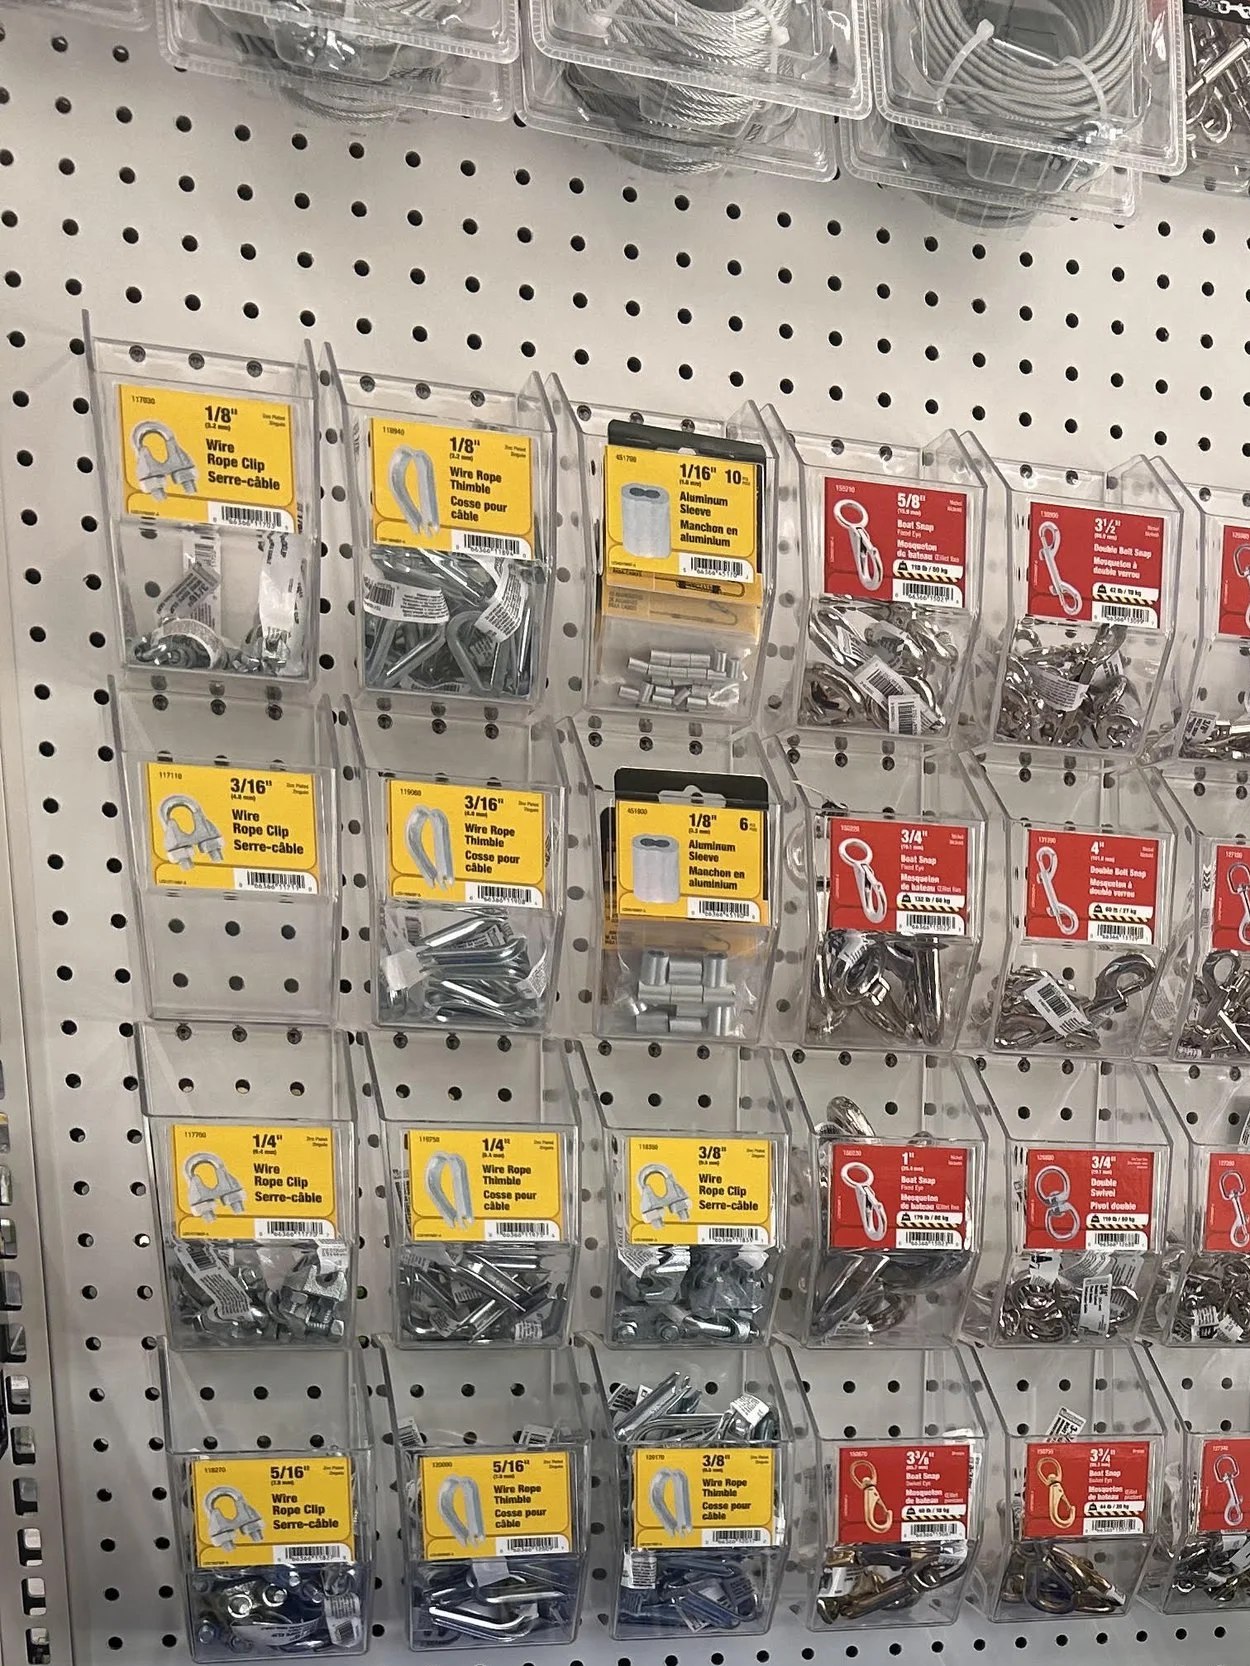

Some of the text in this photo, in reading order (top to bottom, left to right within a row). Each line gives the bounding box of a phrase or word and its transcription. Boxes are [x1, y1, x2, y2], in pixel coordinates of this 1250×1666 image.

[205, 405, 237, 423] 1/8"
[206, 437, 234, 453] Wire
[450, 436, 480, 454] 1/8"
[207, 453, 266, 473] Rope Clip
[207, 471, 280, 491] Serre-câble
[450, 466, 502, 484] Wire Rope
[680, 463, 741, 484] 1/16" 10
[450, 480, 491, 495] Thimble
[450, 496, 508, 514] Cosse pour
[680, 491, 729, 507] Aluminum
[897, 491, 926, 510] 5/8"
[451, 510, 479, 523] câble
[680, 505, 712, 518] Sleeve
[680, 520, 724, 536] Manchon
[916, 520, 935, 533] Snap
[680, 532, 730, 548] aluminium
[230, 778, 272, 796] 3/16"
[232, 809, 260, 822] Wire
[689, 812, 717, 829] 1/8"
[232, 822, 289, 839] Rope Clip
[900, 829, 928, 844] 3/4"
[233, 839, 303, 856] Serre-câble
[1090, 840, 1104, 855] 4"
[919, 854, 937, 866] Snap
[253, 1133, 282, 1149] 1/4"
[254, 1163, 280, 1175] Wire
[255, 1176, 308, 1189] Rope Clip
[255, 1191, 322, 1204] Serre-câble
[493, 1459, 530, 1473] 5/16"
[703, 1454, 730, 1467] 3/8"
[270, 1464, 310, 1479] 5/16"
